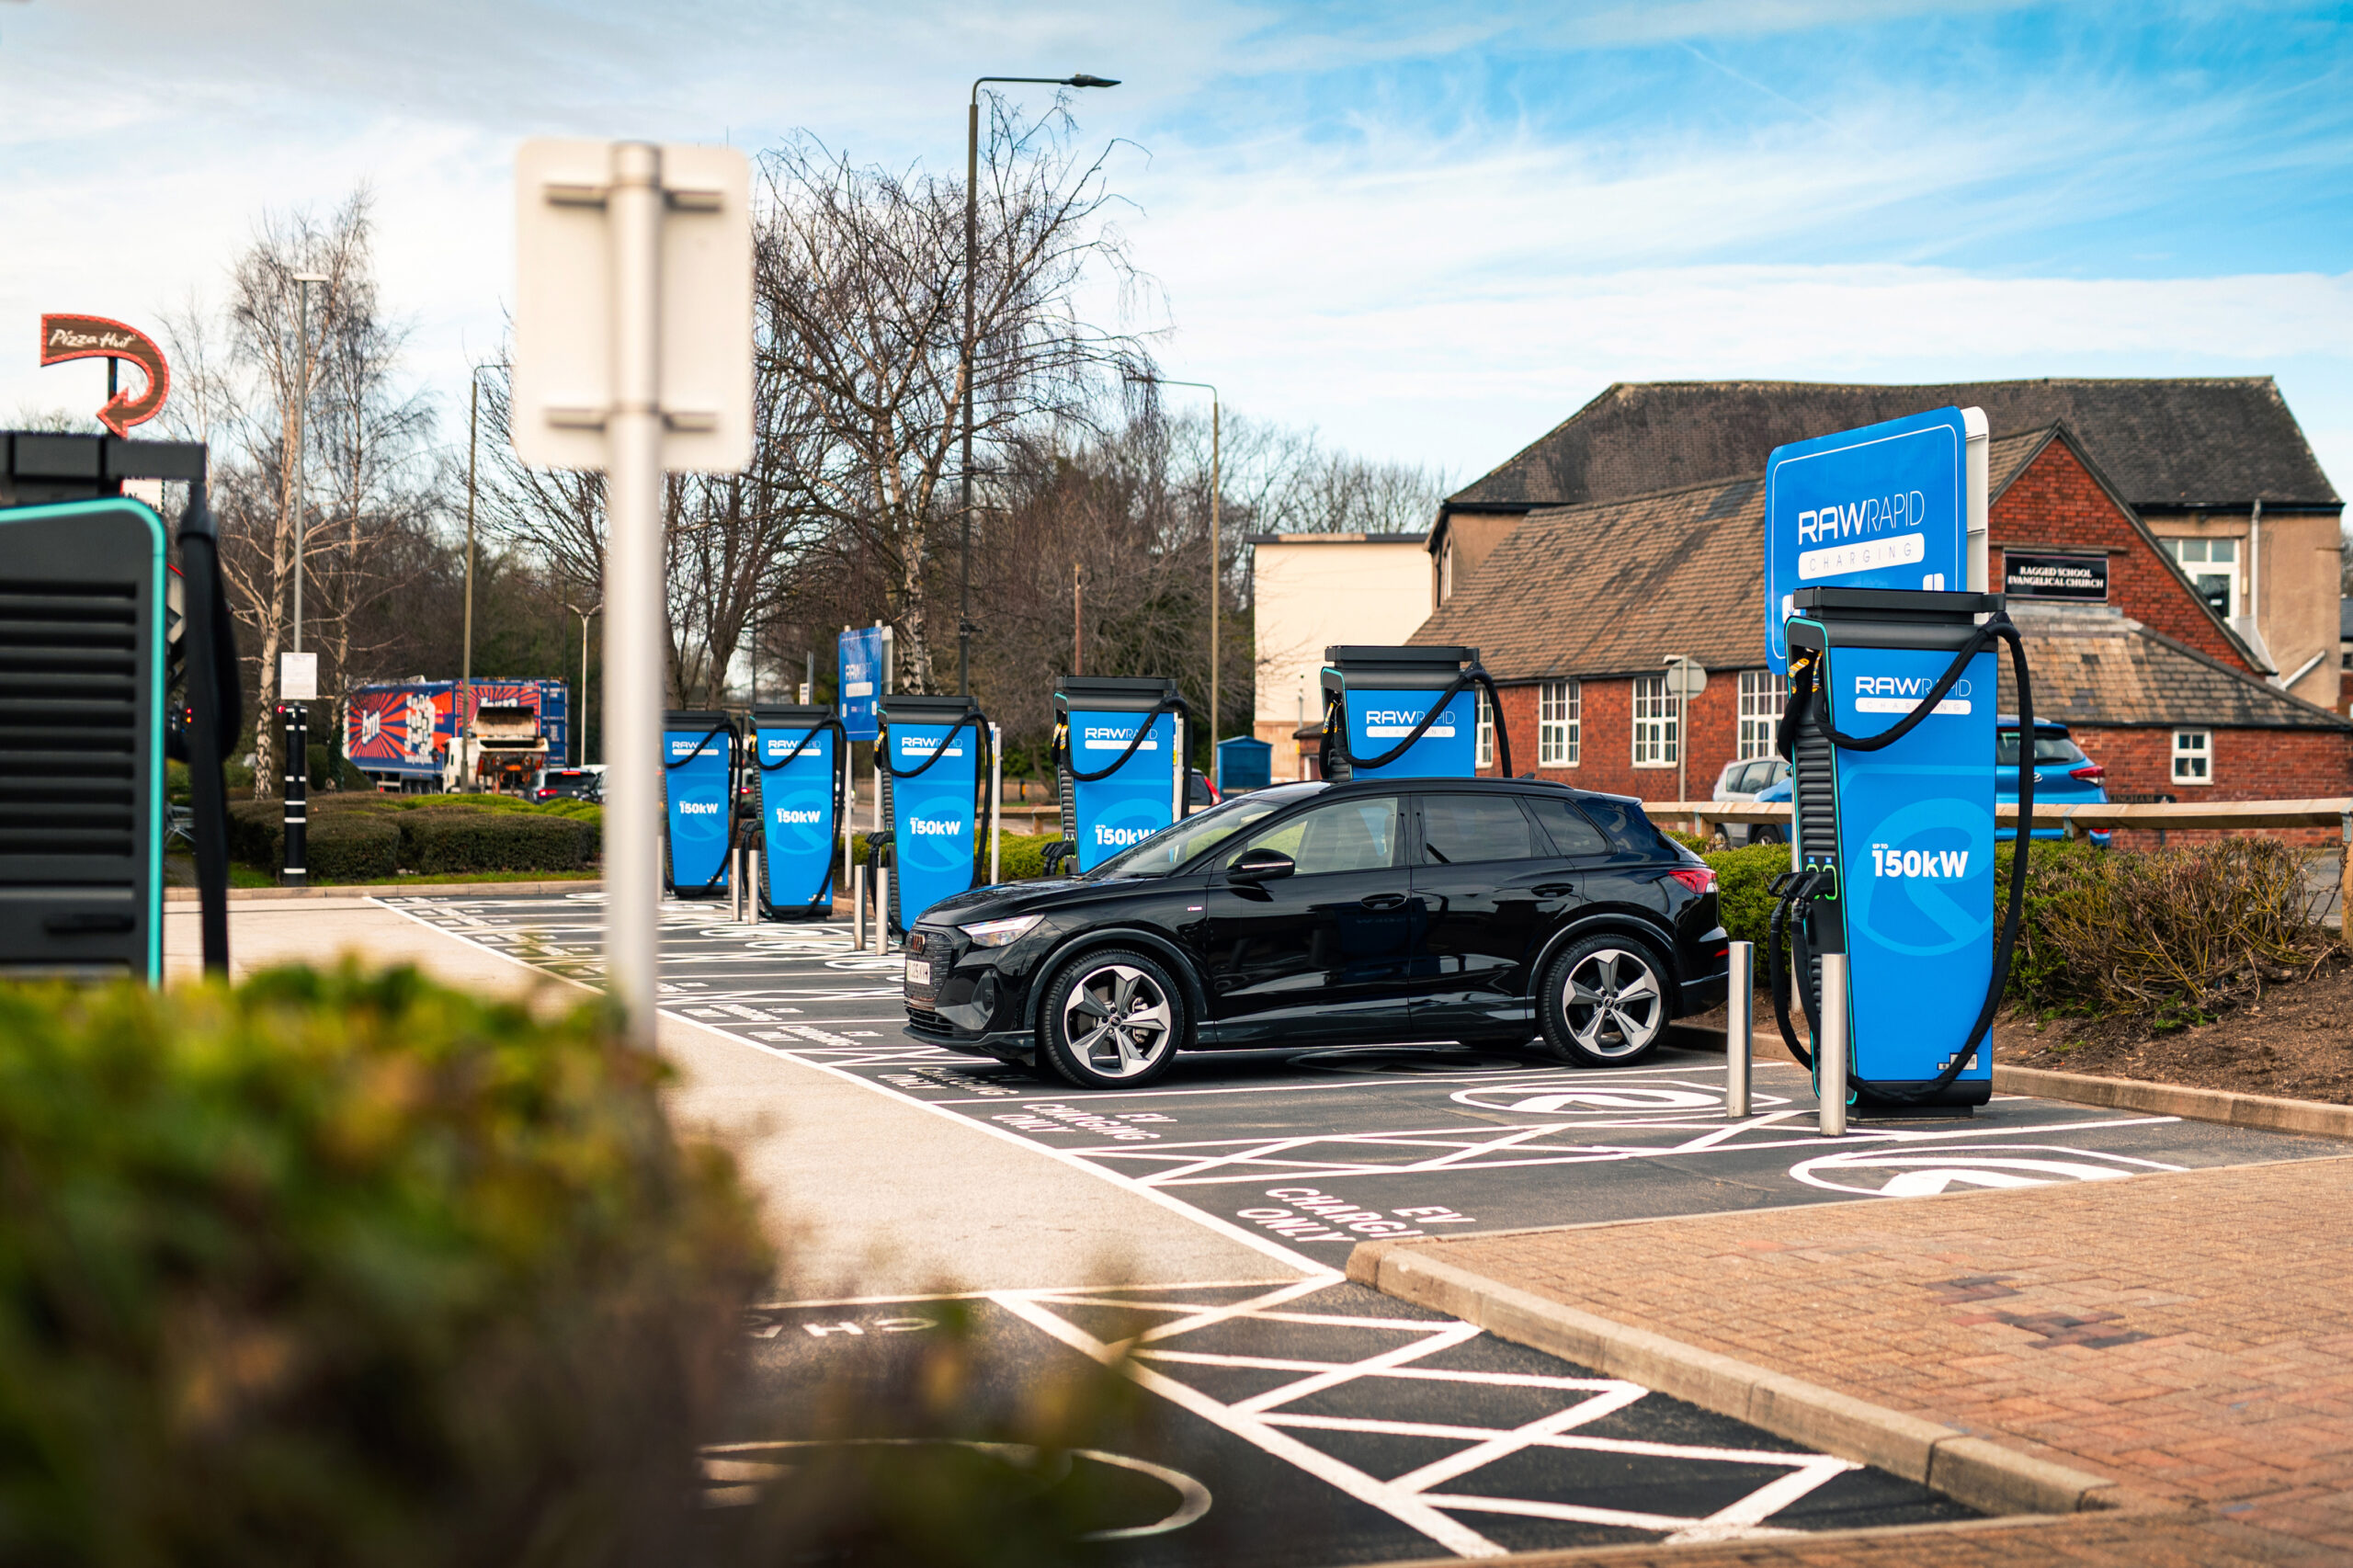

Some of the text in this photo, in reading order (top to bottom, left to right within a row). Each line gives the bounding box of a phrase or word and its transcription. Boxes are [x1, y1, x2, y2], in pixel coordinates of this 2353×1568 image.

[50, 329, 136, 348] Pizza Hut
[1799, 490, 1925, 545] RAWRAPID
[1809, 542, 1912, 572] CHARGING
[2007, 574, 2105, 588] EVANGELICAL CHURCH
[2019, 565, 2093, 578] RAGGED SCHOOL
[1855, 676, 1972, 698] RAWRID
[679, 802, 719, 814] 150kW
[776, 810, 821, 824] 150kW
[909, 820, 961, 835] 150kW
[1871, 850, 1969, 878] 150kW
[991, 1114, 1076, 1132] ONLY
[1022, 1103, 1162, 1141] CHARGING
[1265, 1187, 1425, 1238] CHARGI
[1391, 1206, 1477, 1223] EV
[1236, 1208, 1357, 1243] ONLY
